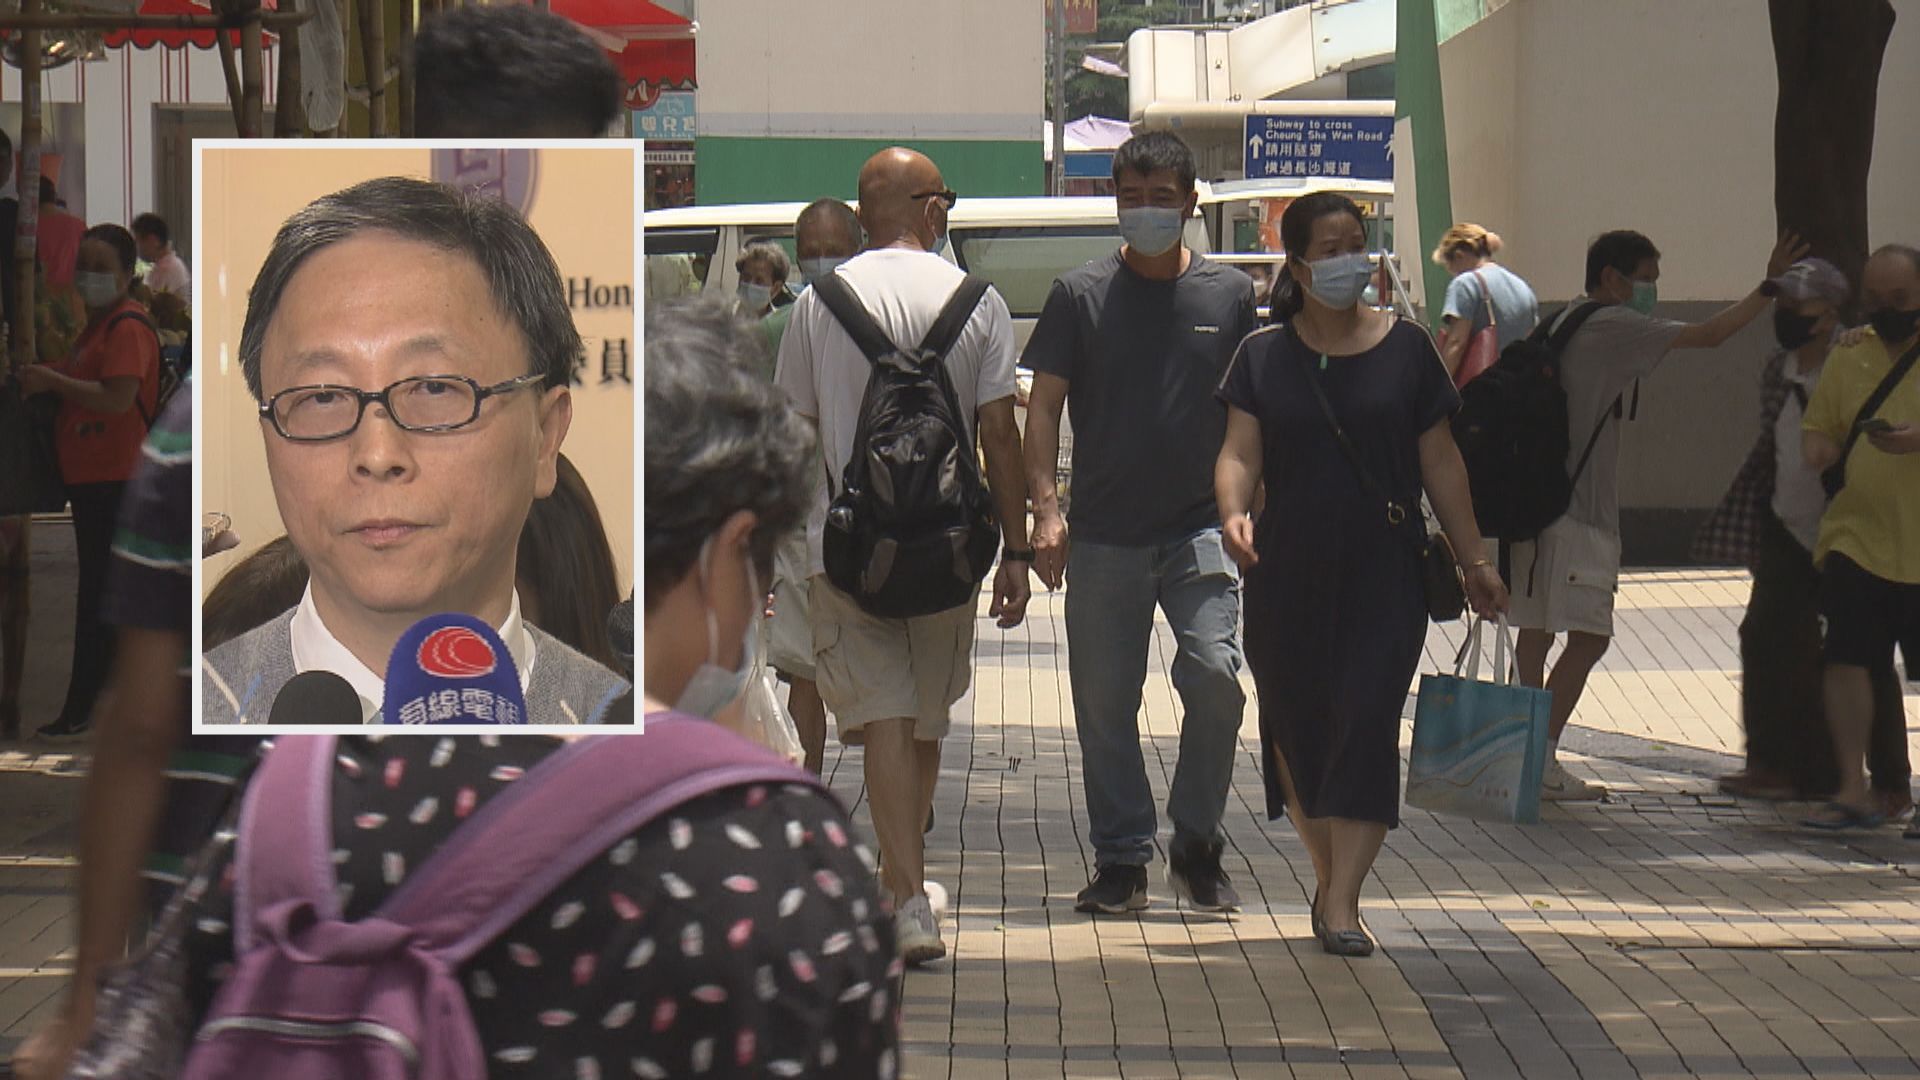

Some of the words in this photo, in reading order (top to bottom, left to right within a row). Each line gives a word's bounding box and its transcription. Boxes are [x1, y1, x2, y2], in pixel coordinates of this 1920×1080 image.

[1265, 130, 1302, 141] Cheung
[1308, 130, 1326, 141] Sha
[1332, 131, 1353, 141] Wan
[1357, 131, 1383, 141] Road
[1266, 118, 1304, 130] Subway
[1309, 119, 1320, 129] to
[1325, 120, 1352, 129] cross
[568, 277, 634, 315] Hon
[571, 338, 631, 386] 員
